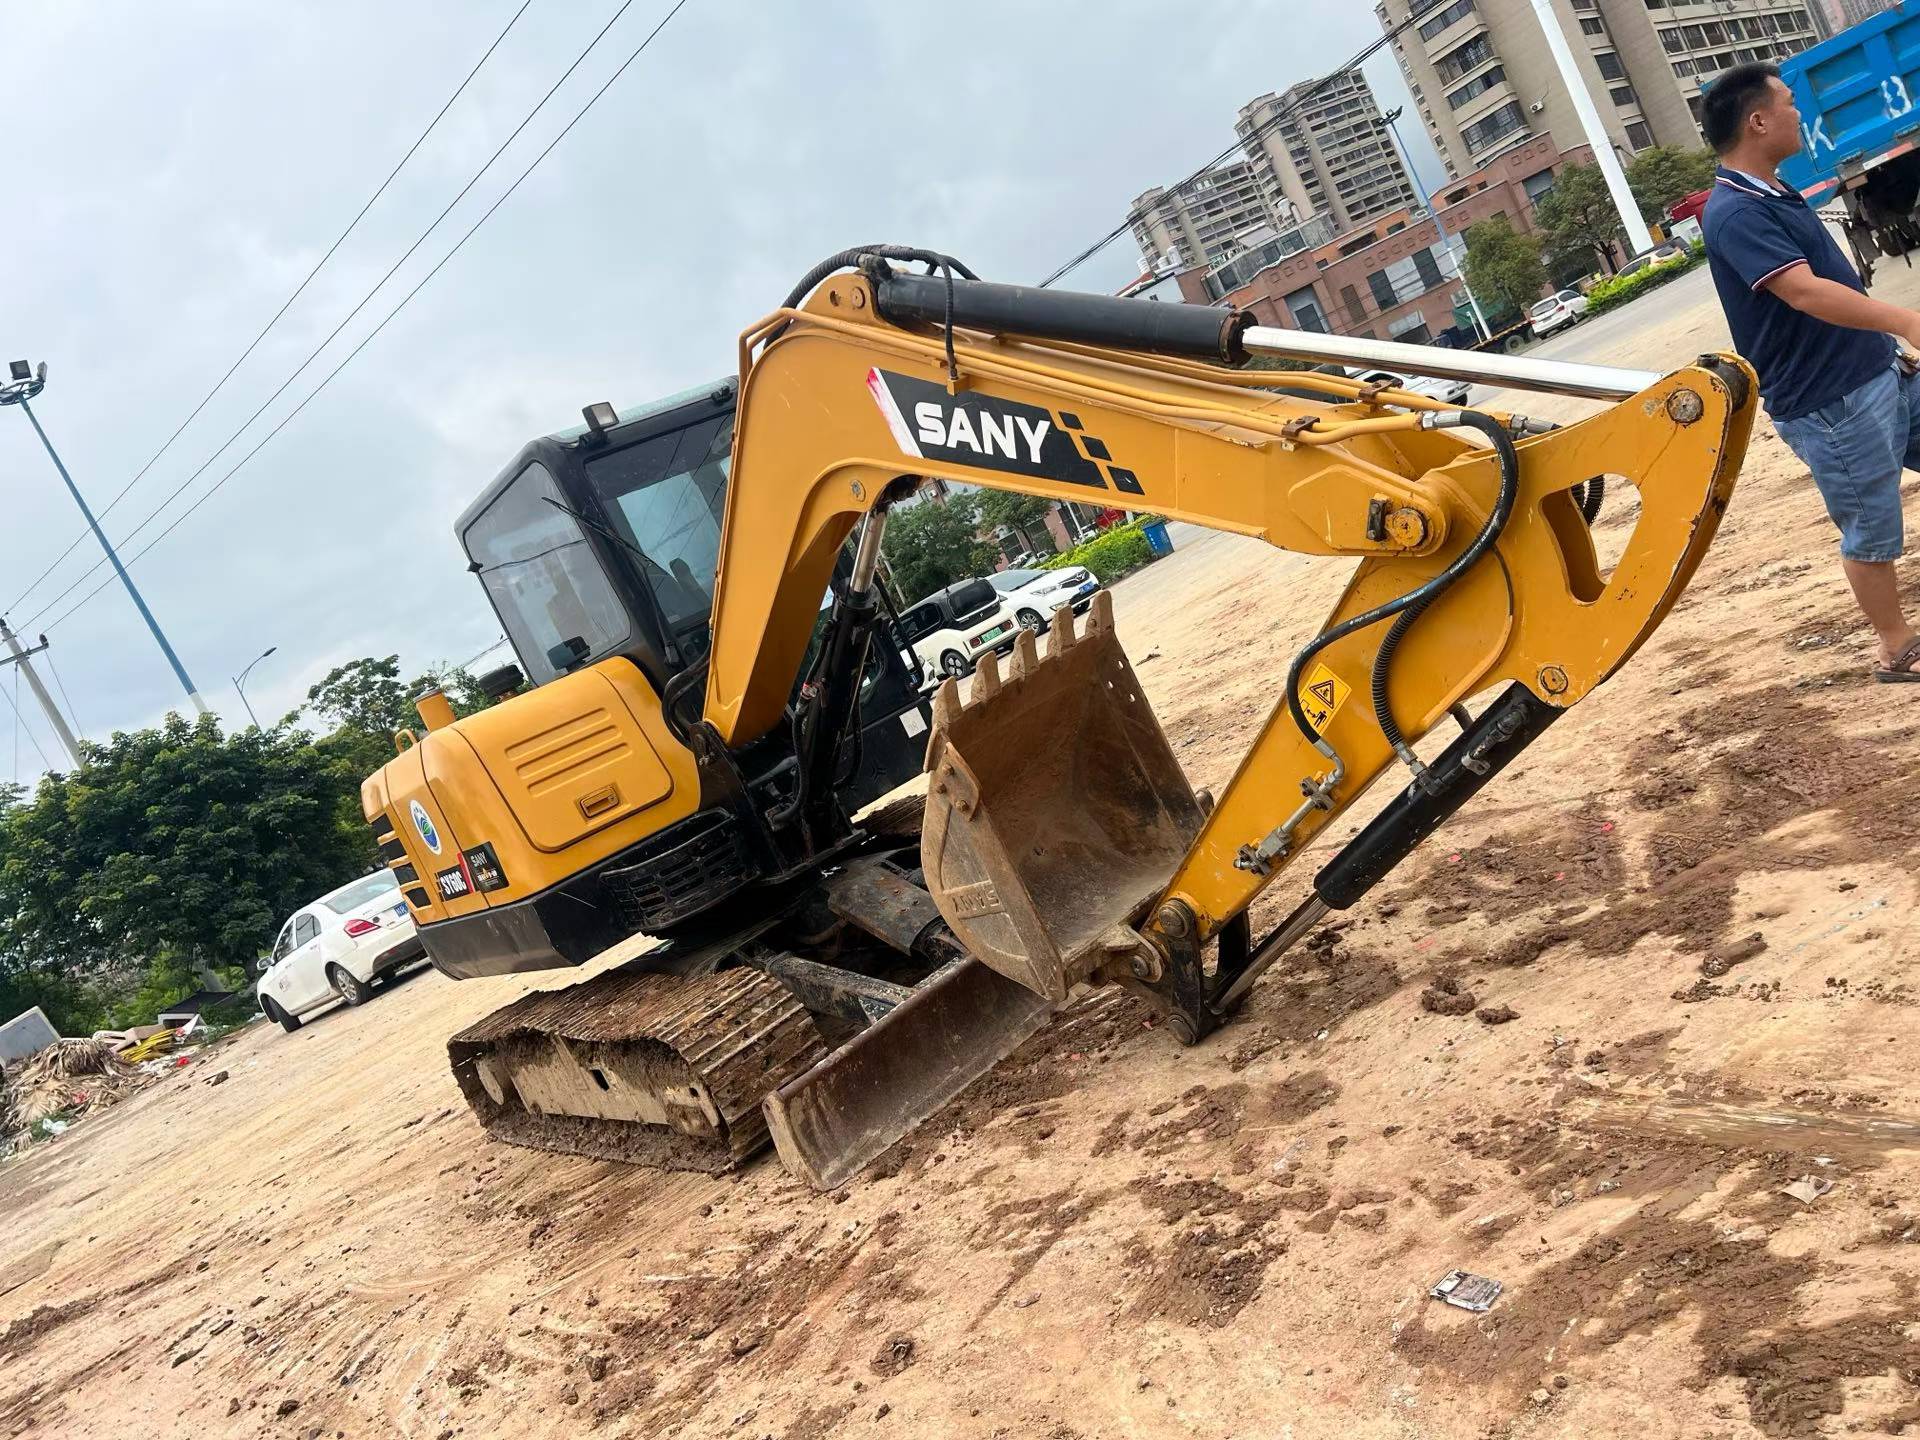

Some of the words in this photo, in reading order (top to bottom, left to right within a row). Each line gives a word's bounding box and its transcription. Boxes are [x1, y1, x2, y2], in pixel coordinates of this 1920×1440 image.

[1803, 115, 1836, 159] K
[914, 401, 1051, 464] SANY
[470, 851, 488, 868] SANY
